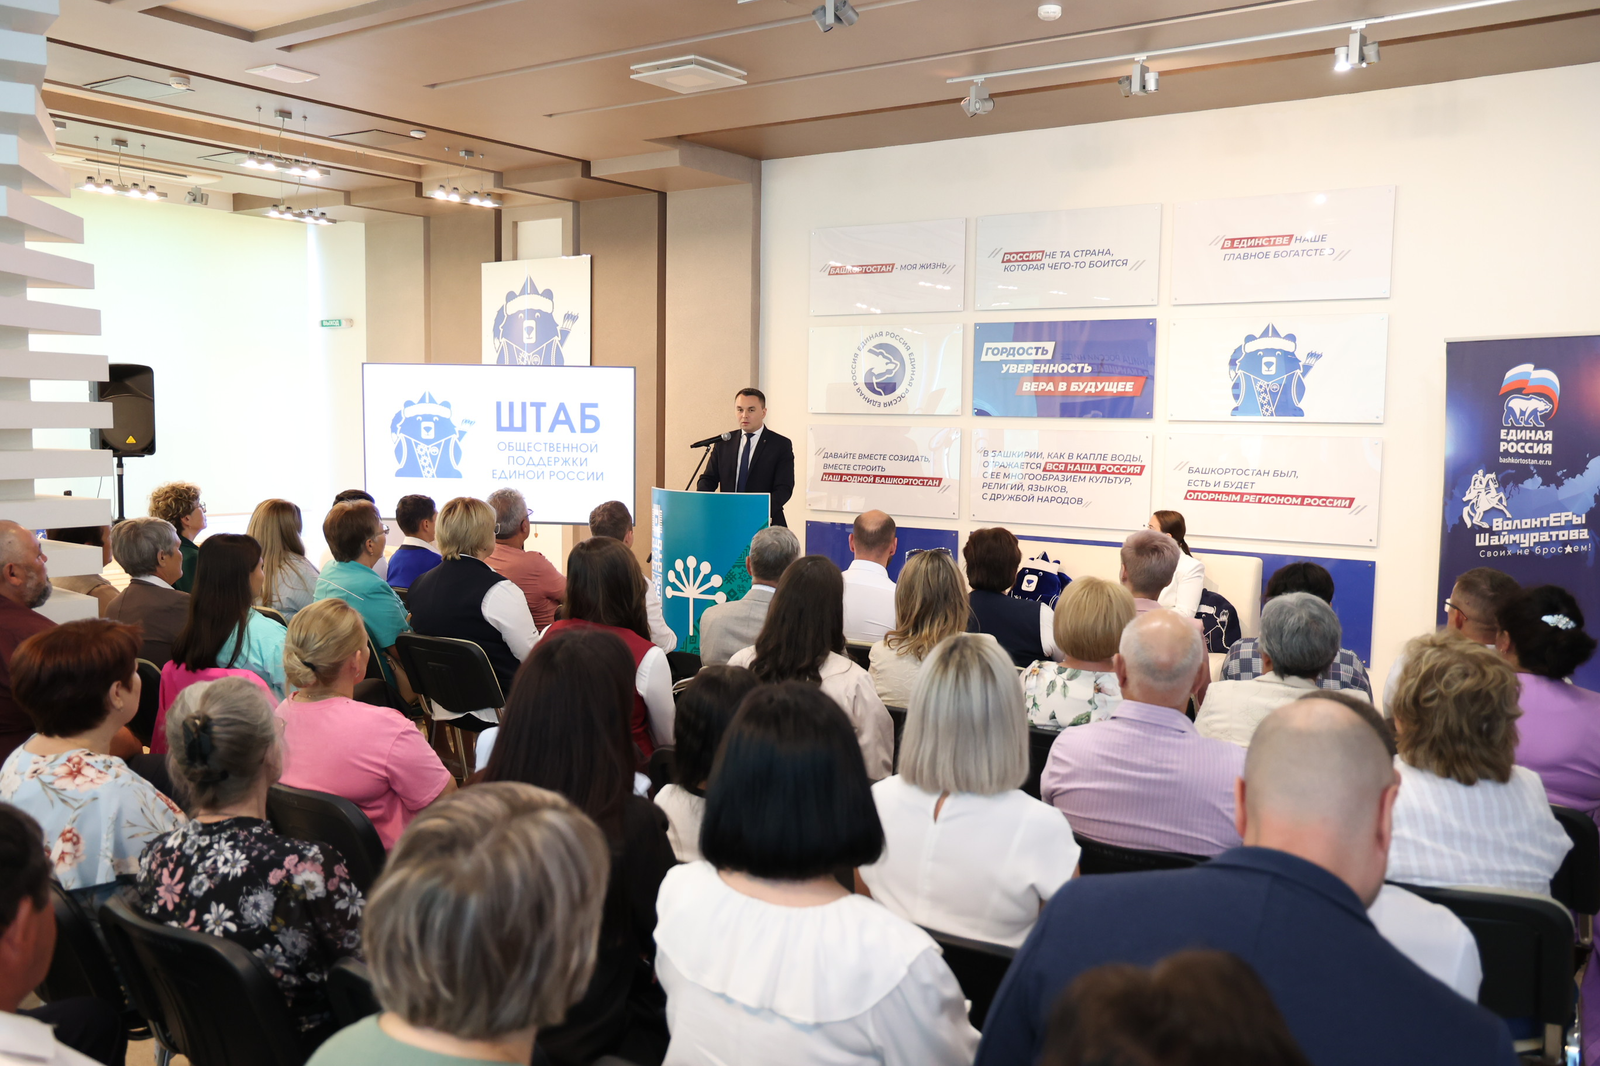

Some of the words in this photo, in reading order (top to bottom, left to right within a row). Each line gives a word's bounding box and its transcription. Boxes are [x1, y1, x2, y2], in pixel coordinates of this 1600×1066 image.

[1224, 240, 1231, 248] В
[1233, 236, 1290, 248] ЕДИНСТВЕ
[1294, 234, 1327, 243] НАШЕ
[1004, 252, 1042, 261] РОССИЯ
[1060, 250, 1071, 258] ТА
[1074, 249, 1114, 258] СТРАНА,
[1223, 251, 1271, 261] ГЛАВНОЕ
[1004, 264, 1045, 272] КОТОРАЯ
[1048, 262, 1086, 270] ЧЕГО-ТО
[1089, 259, 1128, 268] БОИТСЯ
[857, 331, 883, 351] ЕДИНАЯ
[886, 331, 911, 351] РОССИЯ
[985, 347, 1048, 357] ГОРДОСТЬ
[851, 353, 859, 386] РОССИЯ
[908, 352, 916, 387] ЕДИНАЯ
[1001, 364, 1092, 374] УВЕРЕННОСТЬ
[1022, 382, 1054, 391] ВЕРА
[1058, 382, 1067, 391] В
[1070, 382, 1134, 393] БУДУЩЕЕ
[856, 387, 881, 407] ЕДИНАЯ
[883, 388, 909, 408] РОССИЯ
[496, 401, 600, 433] ШТАБ
[1500, 429, 1553, 441] ЕДИНАЯ
[497, 441, 598, 453] ОБЩЕСТВЕННОЙ
[1500, 442, 1552, 454] РОССИЯ
[508, 456, 588, 467] ПОДДЕРЖКИ
[889, 454, 930, 462] СОЗИДАТЬ,
[1047, 452, 1065, 460] КАК
[1076, 453, 1108, 461] КАПЛЕ
[1111, 454, 1143, 463] ВОДЫ,
[1499, 456, 1551, 465] bashkortostan.er.ru
[853, 464, 885, 472] СТРОИТЬ
[1067, 464, 1097, 472] НАША
[1100, 465, 1141, 473] РОССИЯ
[1188, 466, 1270, 477] БАШКОРТОСТАН
[1273, 470, 1298, 479] БЫЛ,
[492, 468, 544, 480] ЕДИНОЙ
[549, 471, 604, 481] РОССИИ
[842, 475, 873, 483] РОДНОЙ
[875, 477, 939, 486] БАШКОРТОСТАН
[1003, 472, 1086, 482] МНОГООБРАЗИЕМ
[1089, 476, 1132, 485] КУЛЬТУР,
[982, 482, 1025, 492] РЕЛИГИЙ,
[1028, 484, 1068, 494] ЯЗЫКОВ,
[1223, 481, 1255, 489] БУДЕТ
[989, 493, 1034, 502] ДРУЖБОЙ
[1037, 496, 1083, 505] НАРОДОВ
[1187, 492, 1241, 501] ОПОРНЫМ
[1243, 495, 1301, 505] РЕГИОНОМ
[1304, 498, 1349, 507] РОССИИ
[1476, 529, 1589, 547] Шаймуратова
[1480, 549, 1512, 557] Своих
